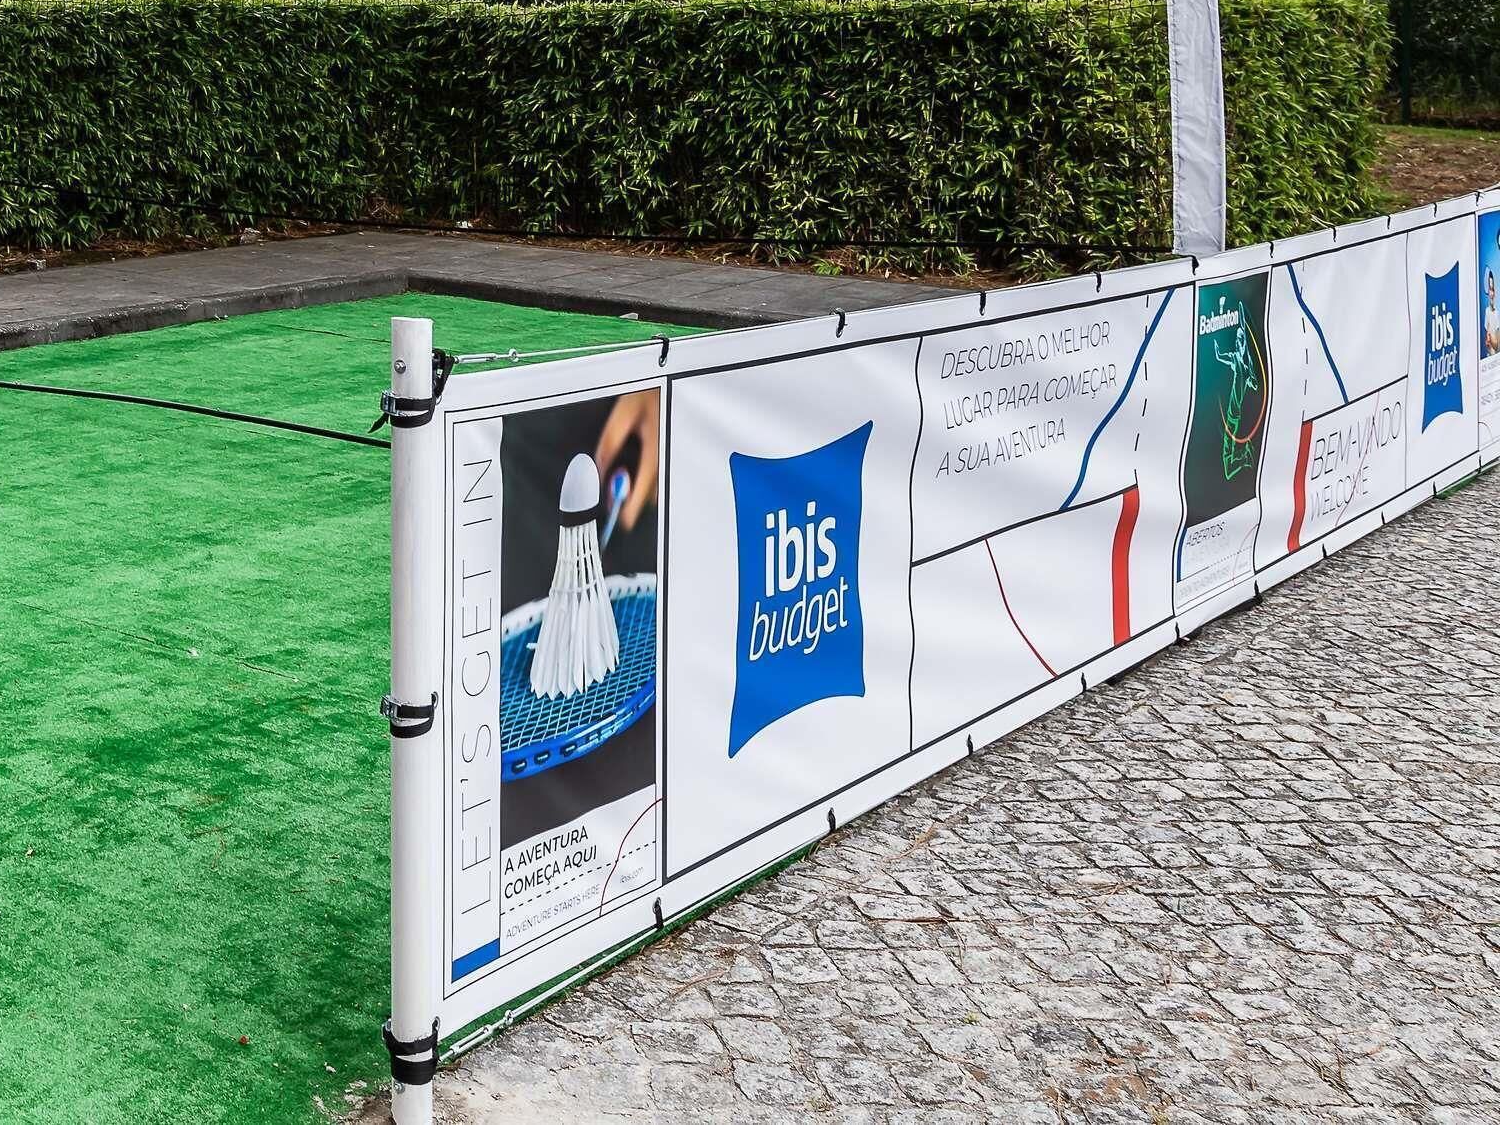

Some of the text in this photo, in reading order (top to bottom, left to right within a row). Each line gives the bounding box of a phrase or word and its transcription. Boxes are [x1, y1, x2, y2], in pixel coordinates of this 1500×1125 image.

[940, 321, 1111, 379] DESCUBRA O MELHOR
[1199, 309, 1239, 335] Badminton
[1431, 302, 1454, 352] ibis
[1427, 345, 1458, 386] budget
[943, 363, 1117, 429] LUGAR PARA COMEÇAR
[935, 418, 1066, 478] A SUA AVENTURA
[1310, 401, 1402, 481] BEM-VINDO
[1310, 466, 1369, 521] WELCOME
[765, 501, 837, 598] ibis
[749, 577, 849, 661] budget
[460, 459, 493, 915] LET'S GET IN
[504, 825, 589, 875] A AVENTURA
[504, 845, 598, 899] COMEÇA AQUI
[506, 884, 601, 939] ADVENTURE STARTS HERE
